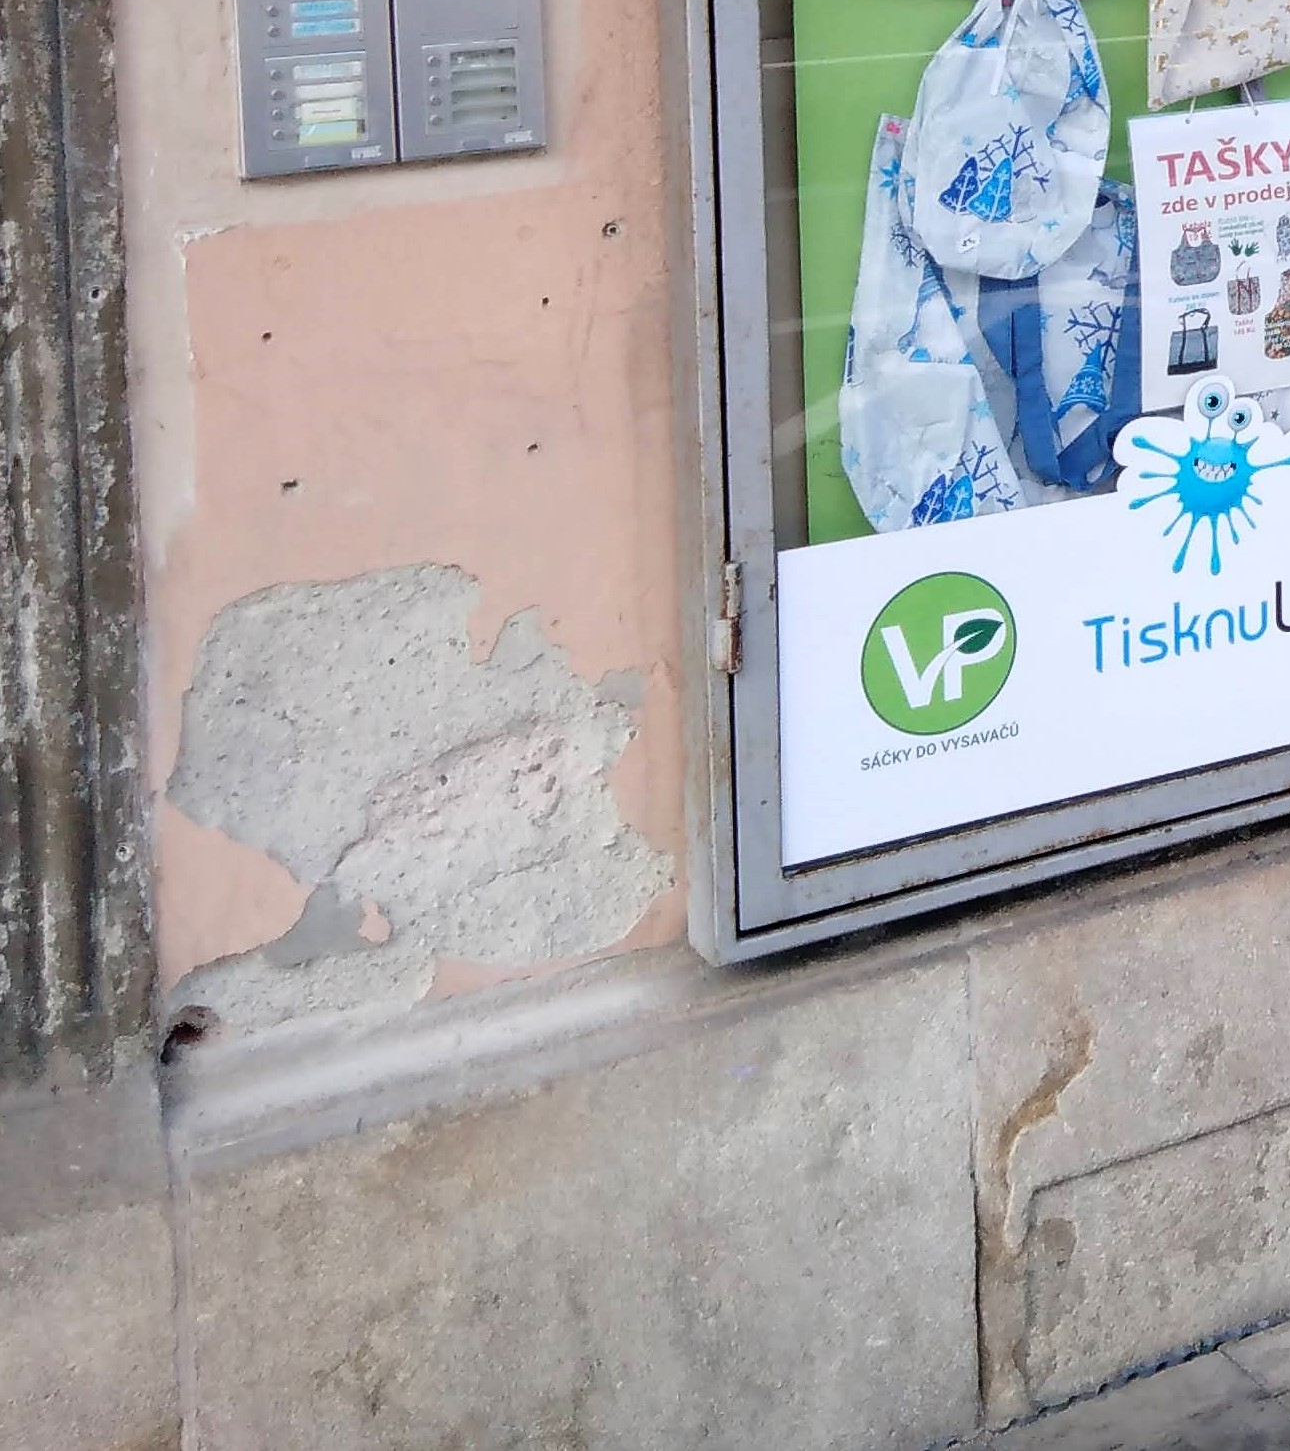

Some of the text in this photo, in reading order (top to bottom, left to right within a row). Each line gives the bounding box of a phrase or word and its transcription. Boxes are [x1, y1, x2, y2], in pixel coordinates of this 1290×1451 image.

[1161, 195, 1199, 215] zde
[1204, 195, 1217, 209] v
[860, 722, 1020, 772] SÁČKY DO VYSAVAČŮ
